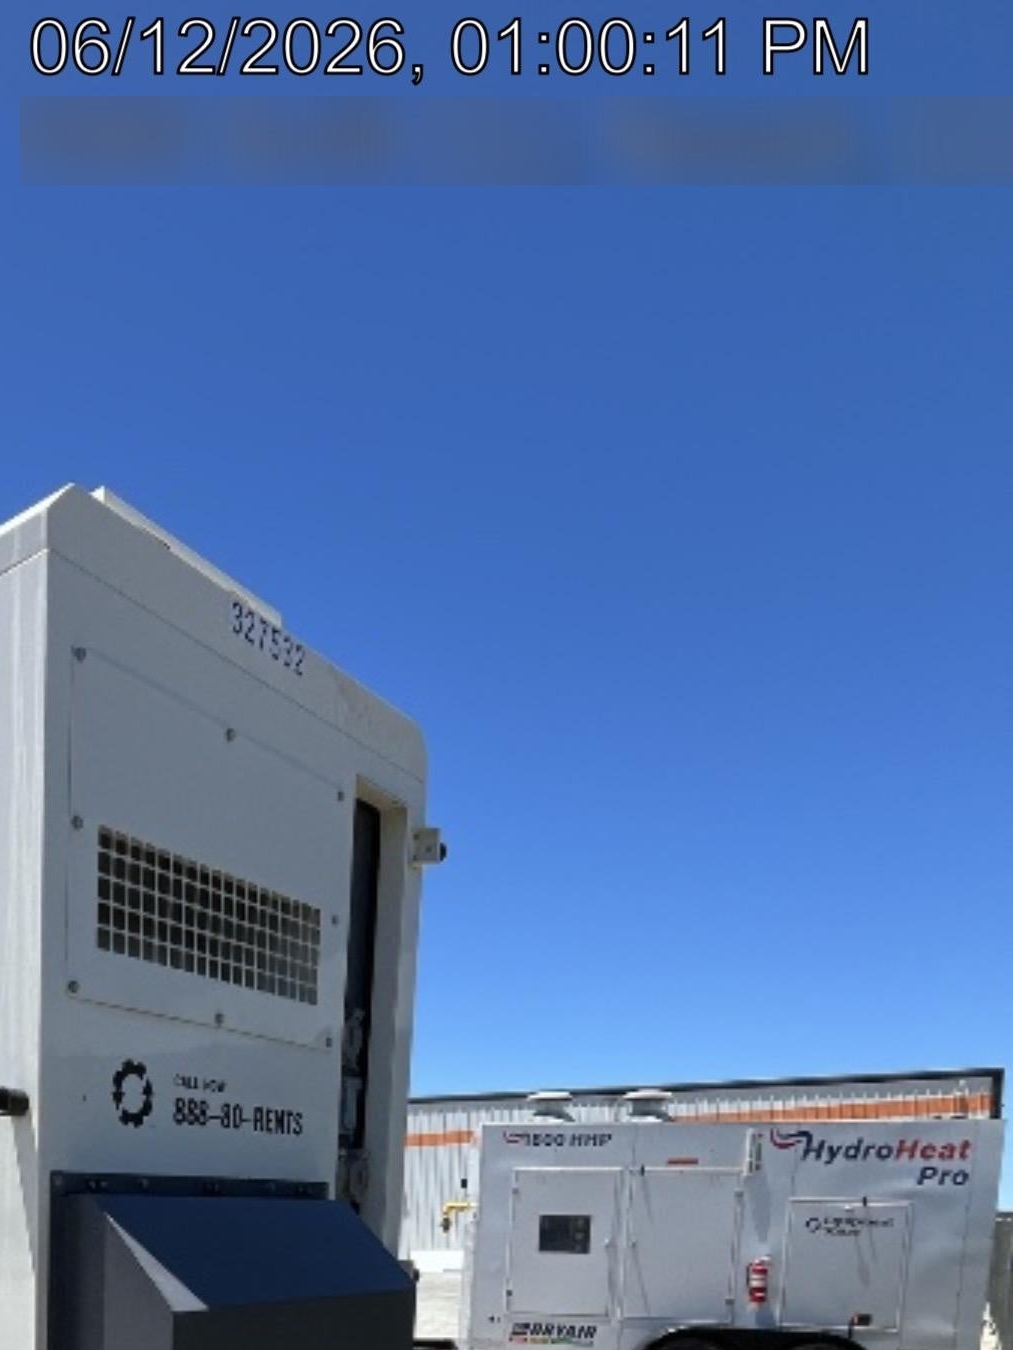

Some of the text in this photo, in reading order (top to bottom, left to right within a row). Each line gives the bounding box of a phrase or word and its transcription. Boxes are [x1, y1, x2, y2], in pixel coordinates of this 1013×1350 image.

[232, 601, 305, 676] 327532
[801, 1134, 972, 1165] HydroHeat
[916, 1166, 970, 1186] Pro
